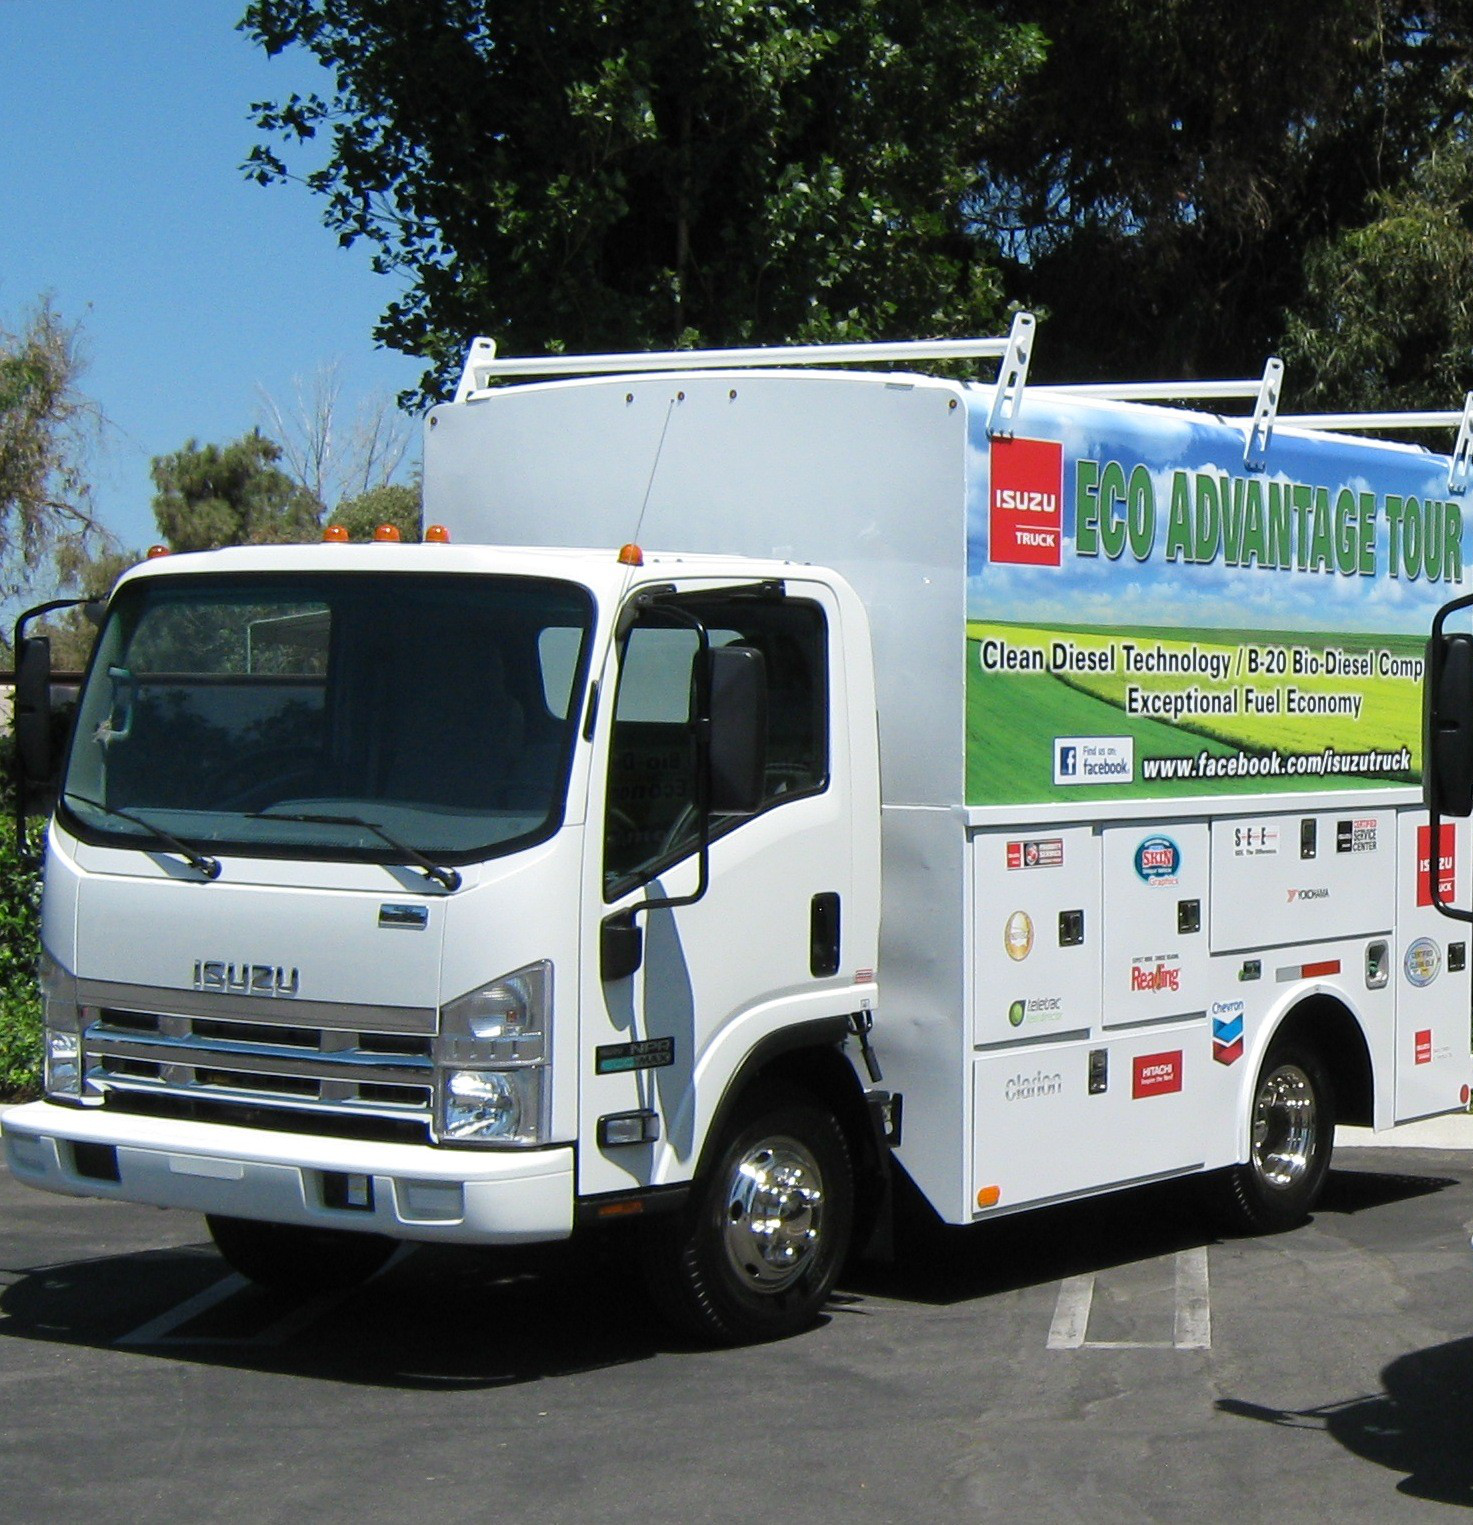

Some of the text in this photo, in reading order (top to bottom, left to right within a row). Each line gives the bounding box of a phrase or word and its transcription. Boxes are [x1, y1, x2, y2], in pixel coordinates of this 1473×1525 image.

[995, 489, 1056, 514] ISUZU
[1075, 459, 1464, 583] ECO ADVANTAGE TOUR
[1015, 531, 1055, 549] TRUCK
[982, 640, 1045, 672] Clean
[1051, 641, 1116, 672] Diesel
[1122, 644, 1231, 680] Technology
[1247, 648, 1287, 675] B-20
[1292, 648, 1374, 676] Bio-Diesel
[1127, 687, 1362, 719] Exceptional Fuel Economy
[1083, 757, 1128, 775] facebook
[1143, 748, 1411, 781] www.facebook.com/isuzutruck
[1353, 841, 1378, 852] CENTER
[1143, 850, 1172, 866] SKIN
[1420, 856, 1453, 872] ISZU
[194, 959, 299, 995] ISUZU
[1131, 963, 1181, 991] Reading
[1212, 1000, 1244, 1014] Chevron
[1142, 1063, 1173, 1078] HITACHI
